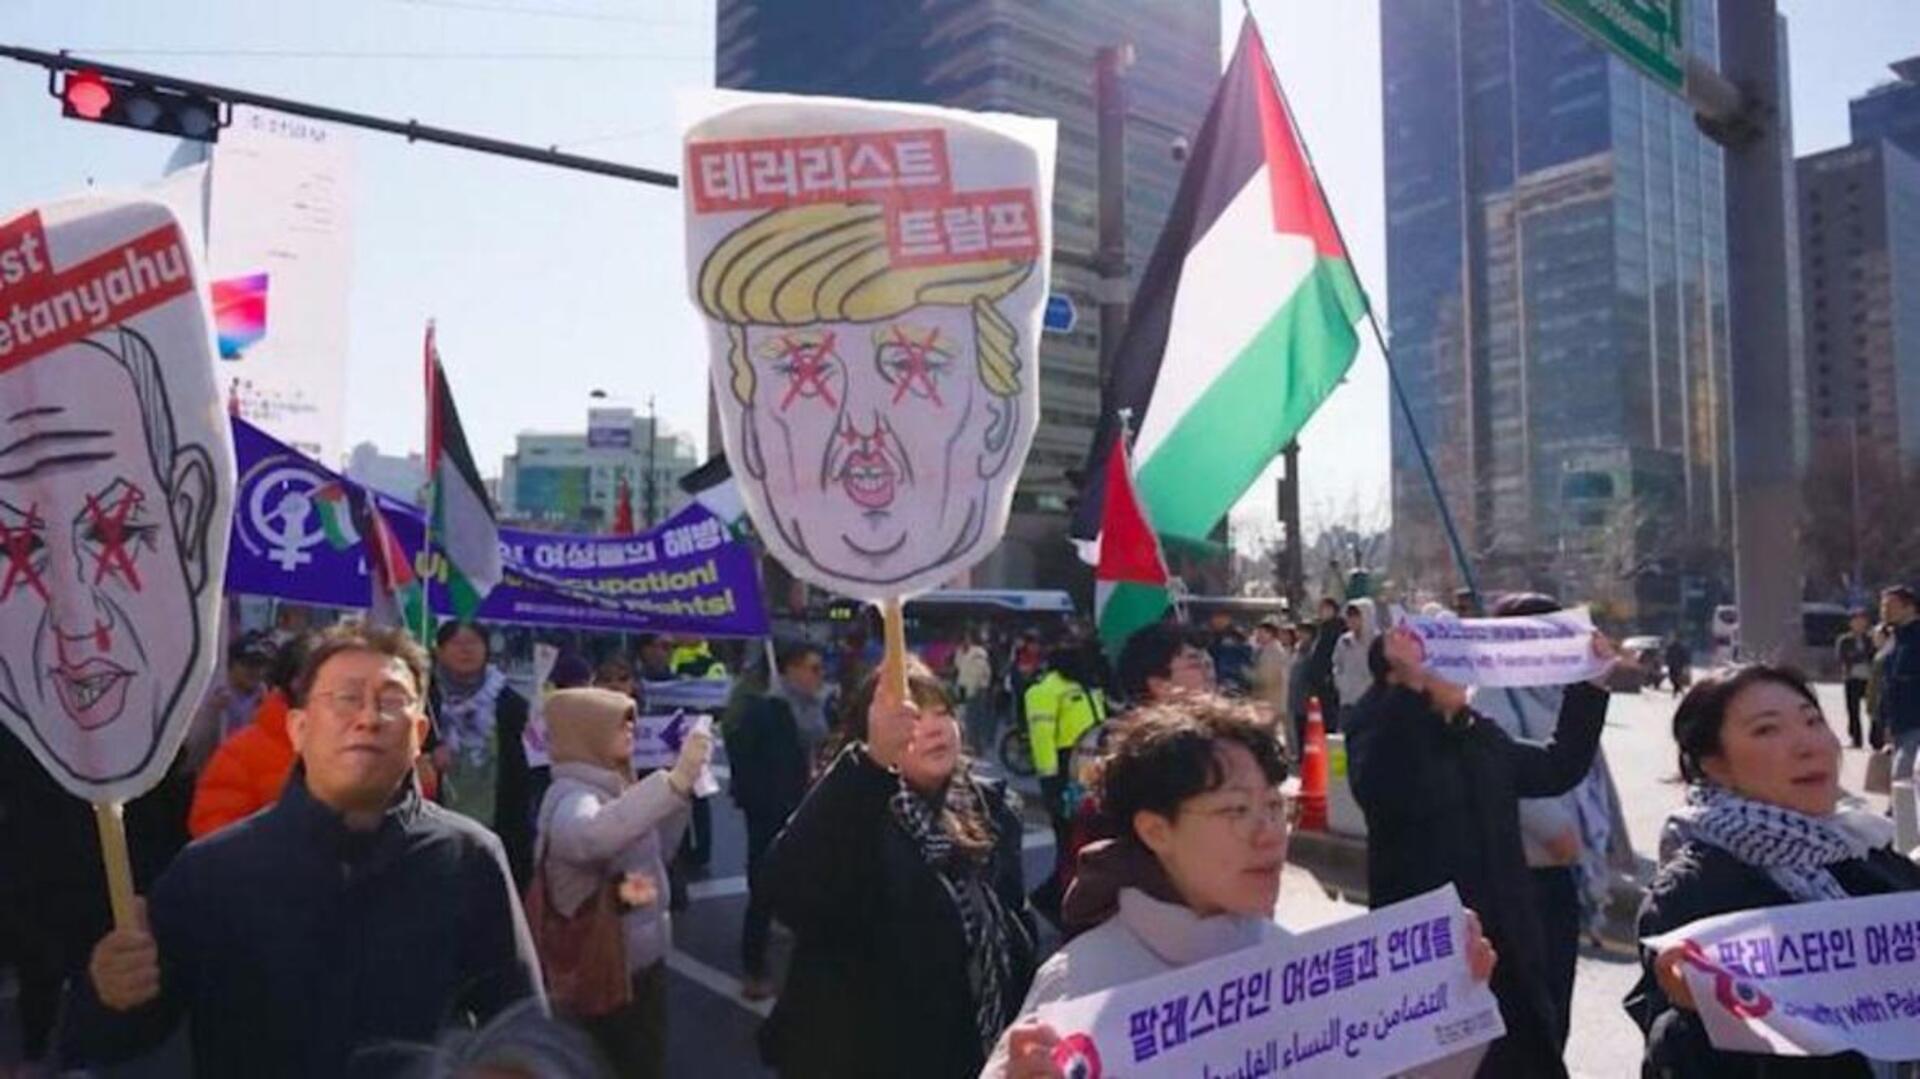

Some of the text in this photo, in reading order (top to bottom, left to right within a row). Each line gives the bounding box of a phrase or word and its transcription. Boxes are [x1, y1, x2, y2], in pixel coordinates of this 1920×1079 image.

[701, 139, 942, 200] 테러리스트
[900, 203, 1033, 254] 트럼프
[1865, 919, 1920, 966] 여성
[1128, 914, 1455, 1062] 팔레스타인 여성들과 연대를
